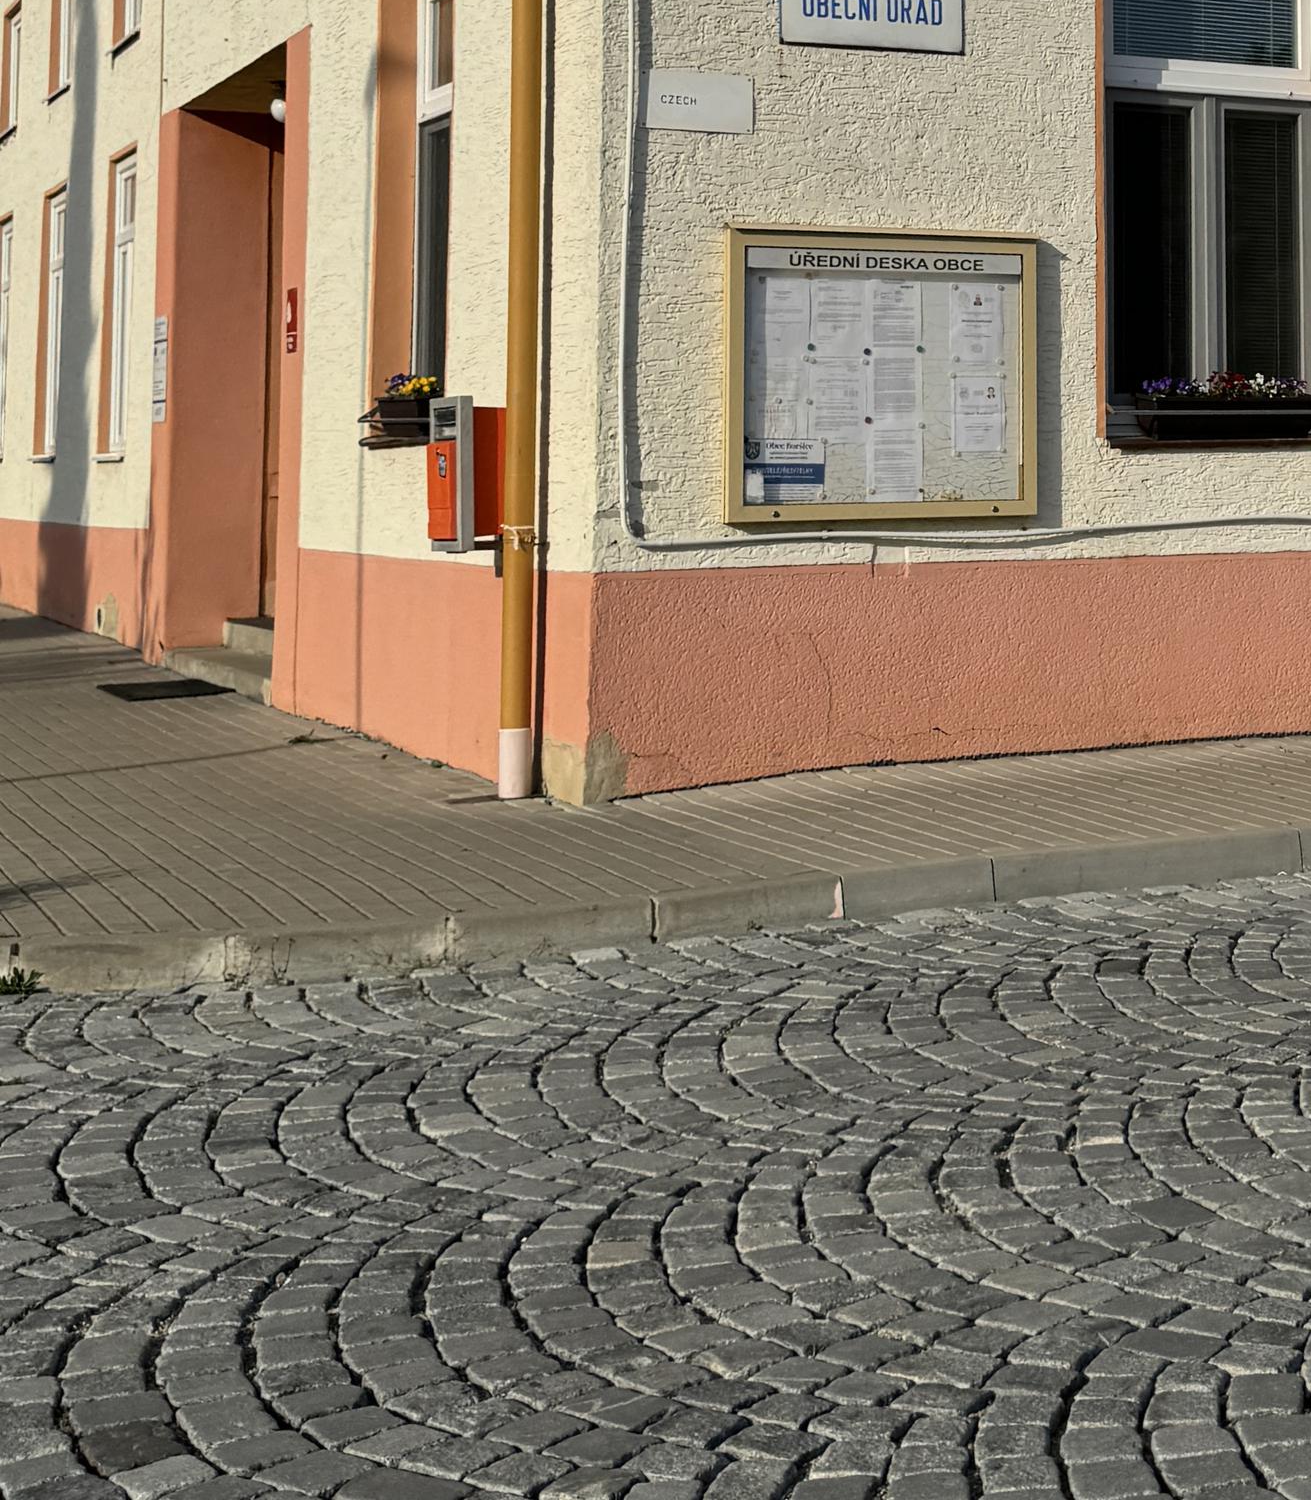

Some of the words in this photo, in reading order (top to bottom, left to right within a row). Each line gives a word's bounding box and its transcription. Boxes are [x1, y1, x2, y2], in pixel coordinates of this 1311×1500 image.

[660, 94, 697, 106] CZECH
[789, 251, 861, 269] ÚŘEDNÍ
[865, 257, 929, 270] DESKA
[933, 258, 985, 272] OBCE
